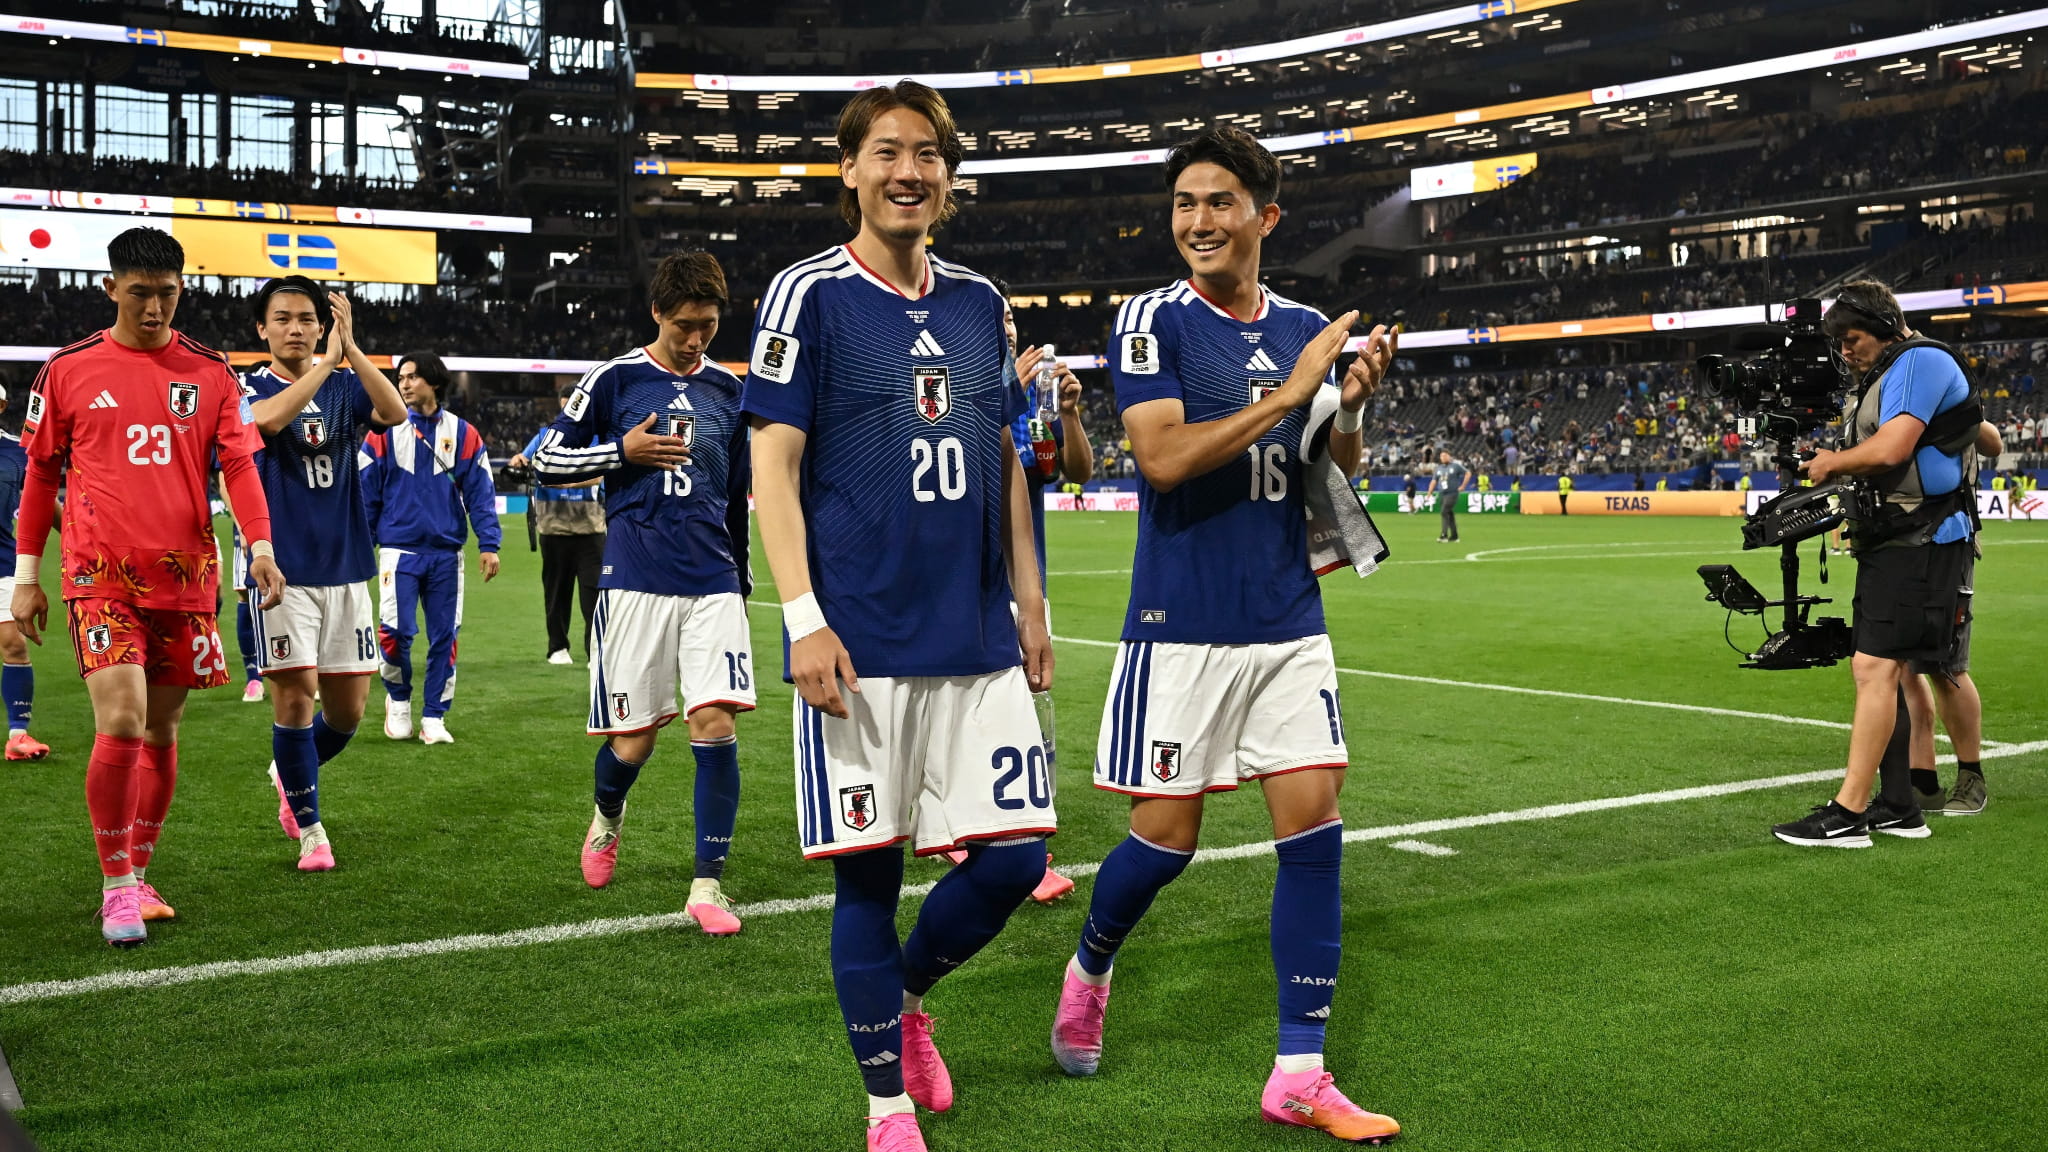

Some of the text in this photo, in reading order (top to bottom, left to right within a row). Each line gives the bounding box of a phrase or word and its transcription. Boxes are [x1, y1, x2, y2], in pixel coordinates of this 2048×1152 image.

[1834, 49, 1857, 60] JAPAN
[139, 199, 150, 209] 1
[195, 201, 207, 212] 1
[126, 424, 172, 465] 23
[1037, 452, 1056, 460] CUP
[302, 454, 334, 489] 18
[663, 458, 693, 497] 15
[910, 436, 967, 503] 20
[1248, 443, 1288, 502] 16
[1604, 496, 1650, 511] TEXAS
[192, 631, 226, 676] 23
[355, 626, 375, 662] 18
[724, 650, 750, 691] 15
[1319, 688, 1345, 746] 1
[847, 786, 866, 794] JAPAN
[991, 745, 1051, 811] 20
[96, 823, 134, 837] JAPAN
[135, 818, 161, 829] APA
[703, 835, 733, 843] JAPA
[1290, 975, 1338, 987] JAPA
